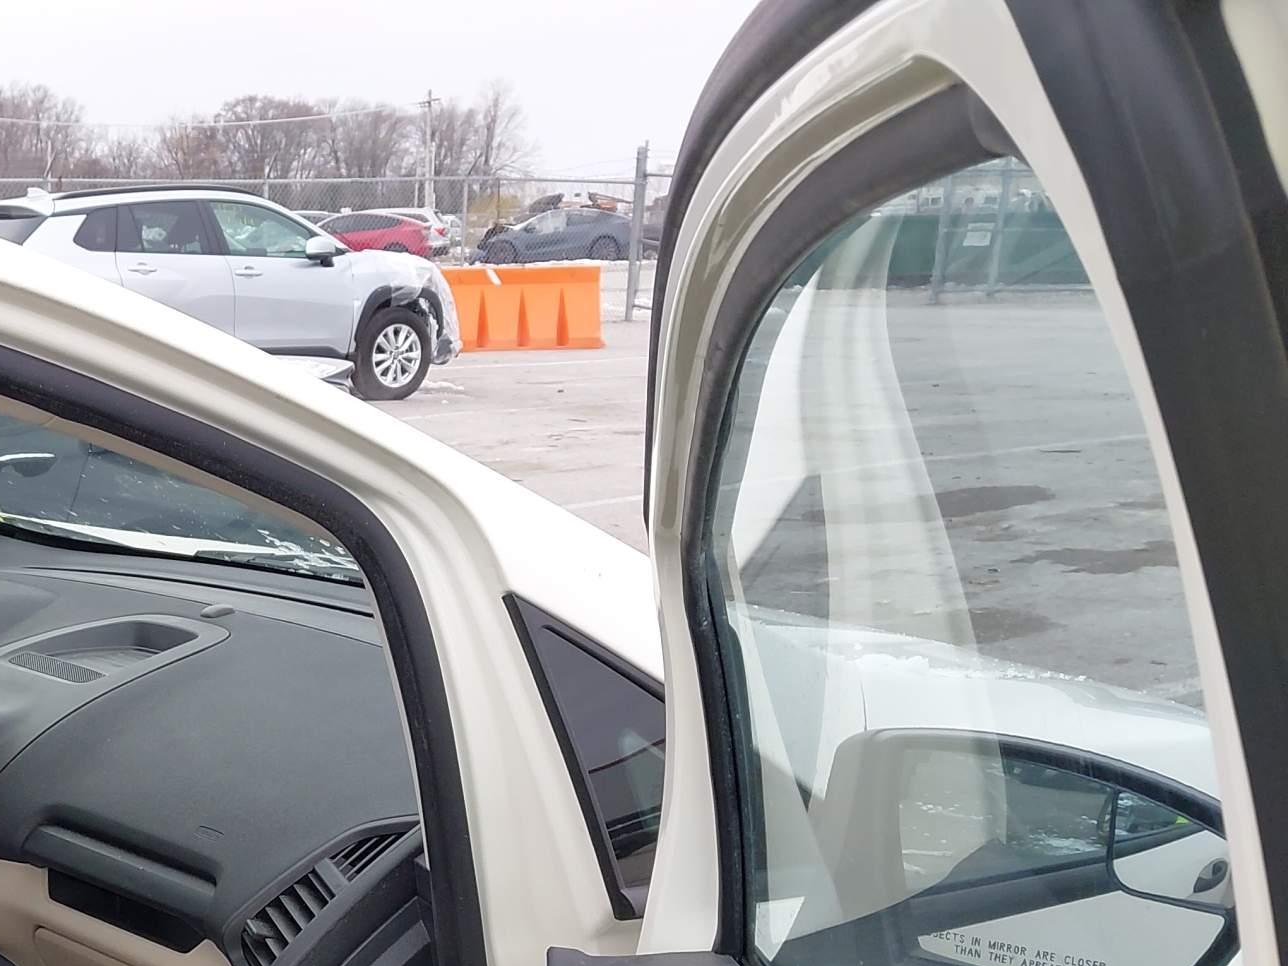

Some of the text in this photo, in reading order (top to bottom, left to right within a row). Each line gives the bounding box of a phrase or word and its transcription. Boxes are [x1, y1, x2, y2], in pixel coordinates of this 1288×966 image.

[932, 932, 965, 944] JECTS
[971, 936, 981, 947] IN
[988, 941, 1027, 956] MIRROR
[1035, 950, 1056, 962] ARE
[954, 945, 981, 958] THAN
[989, 951, 1014, 964] THEY
